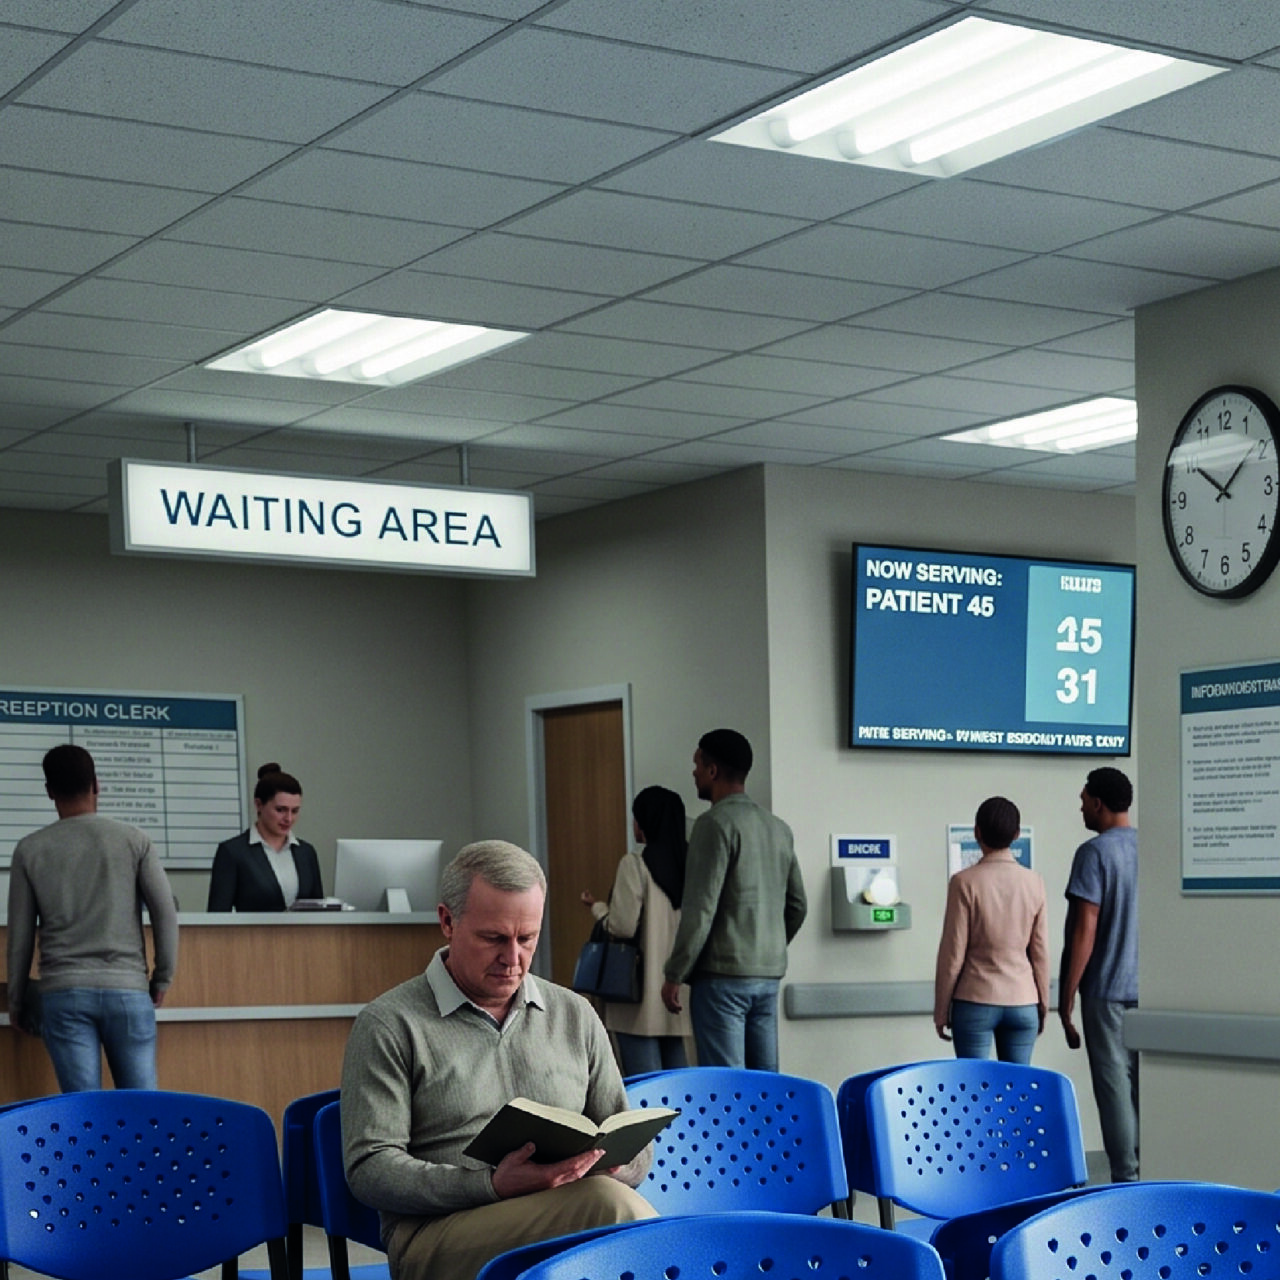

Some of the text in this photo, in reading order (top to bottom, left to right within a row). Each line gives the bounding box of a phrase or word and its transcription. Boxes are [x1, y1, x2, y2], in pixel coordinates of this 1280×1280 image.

[1217, 410, 1232, 431] 12
[1242, 415, 1248, 434] 1
[1258, 439, 1269, 460] 2
[1264, 475, 1273, 495] 3
[1178, 491, 1187, 509] 9
[160, 488, 502, 548] WAITING AREA
[1257, 514, 1267, 534] 4
[1185, 526, 1194, 545] 8
[1201, 549, 1209, 569] 7
[1241, 542, 1250, 562] 5
[866, 559, 1003, 587] NOW SERVING:
[1220, 556, 1230, 575] 6
[866, 588, 994, 617] PATIENT 45
[1056, 616, 1102, 654] 15
[1056, 667, 1097, 704] 31
[0, 699, 170, 721] REEPTION CLERK
